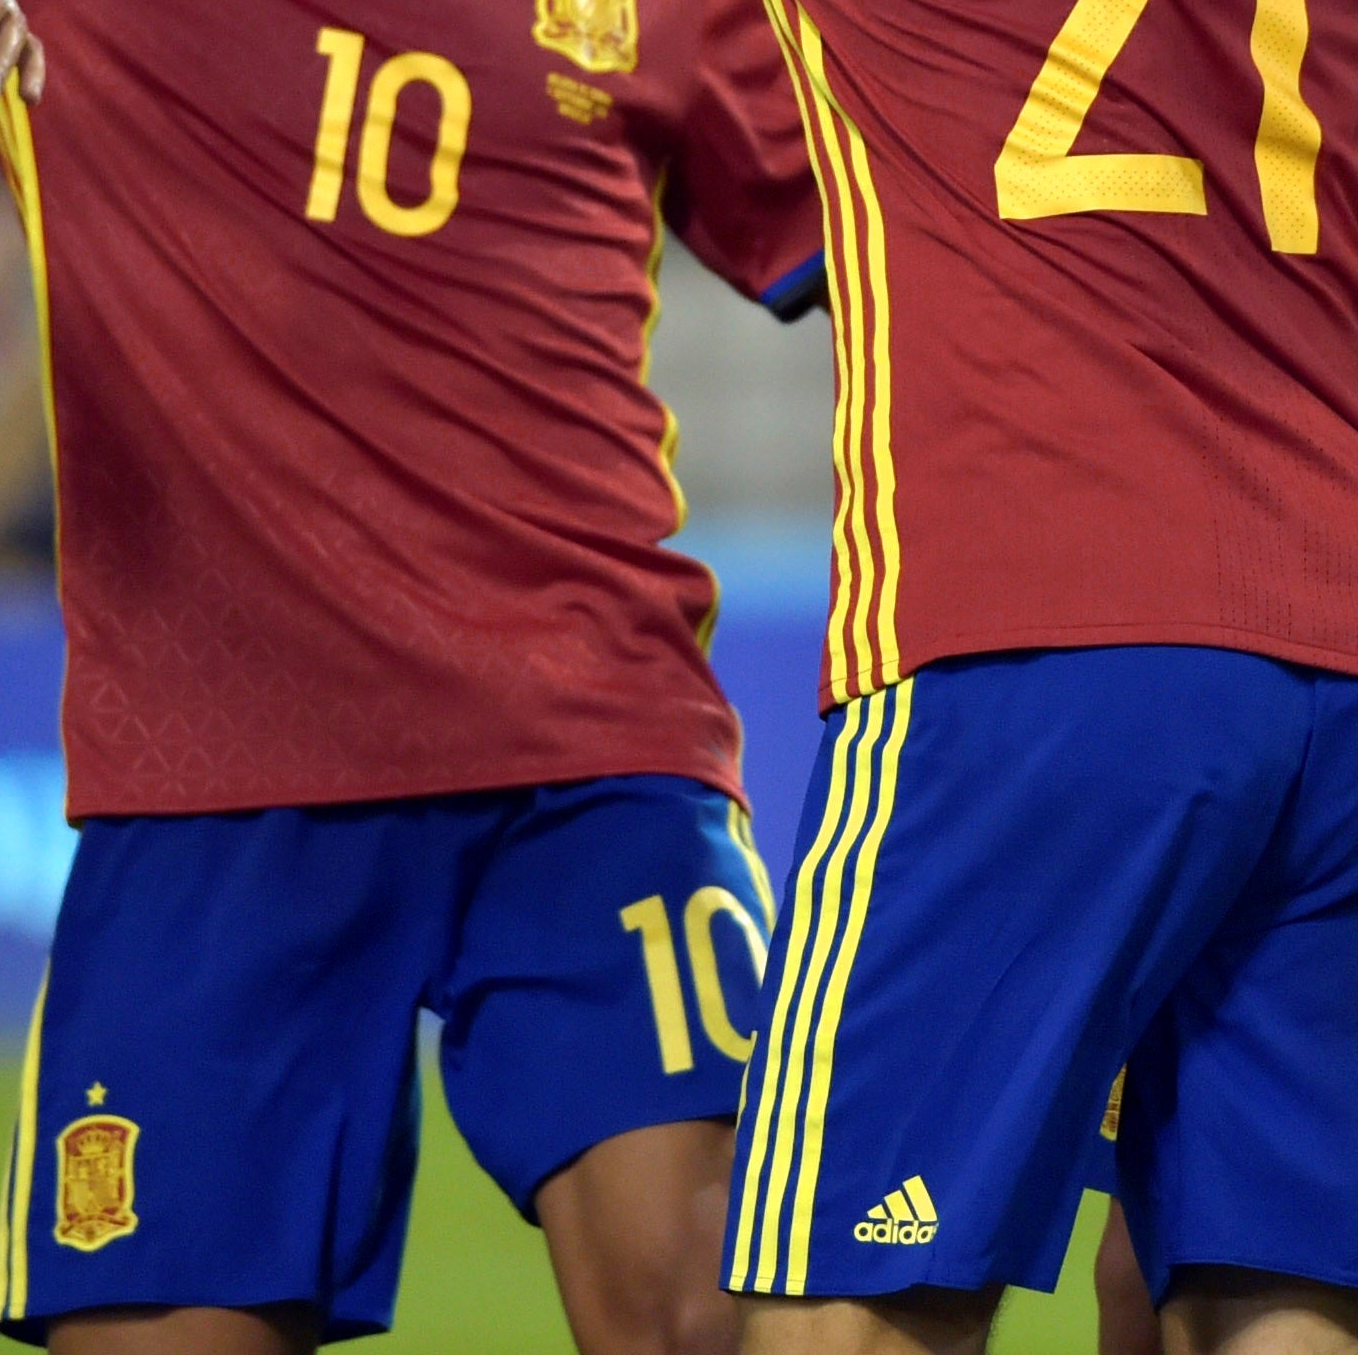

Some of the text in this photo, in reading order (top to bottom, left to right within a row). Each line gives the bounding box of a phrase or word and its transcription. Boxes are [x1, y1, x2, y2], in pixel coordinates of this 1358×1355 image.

[305, 28, 472, 237] 10
[620, 886, 768, 1074] 10
[854, 1218, 939, 1245] adida
